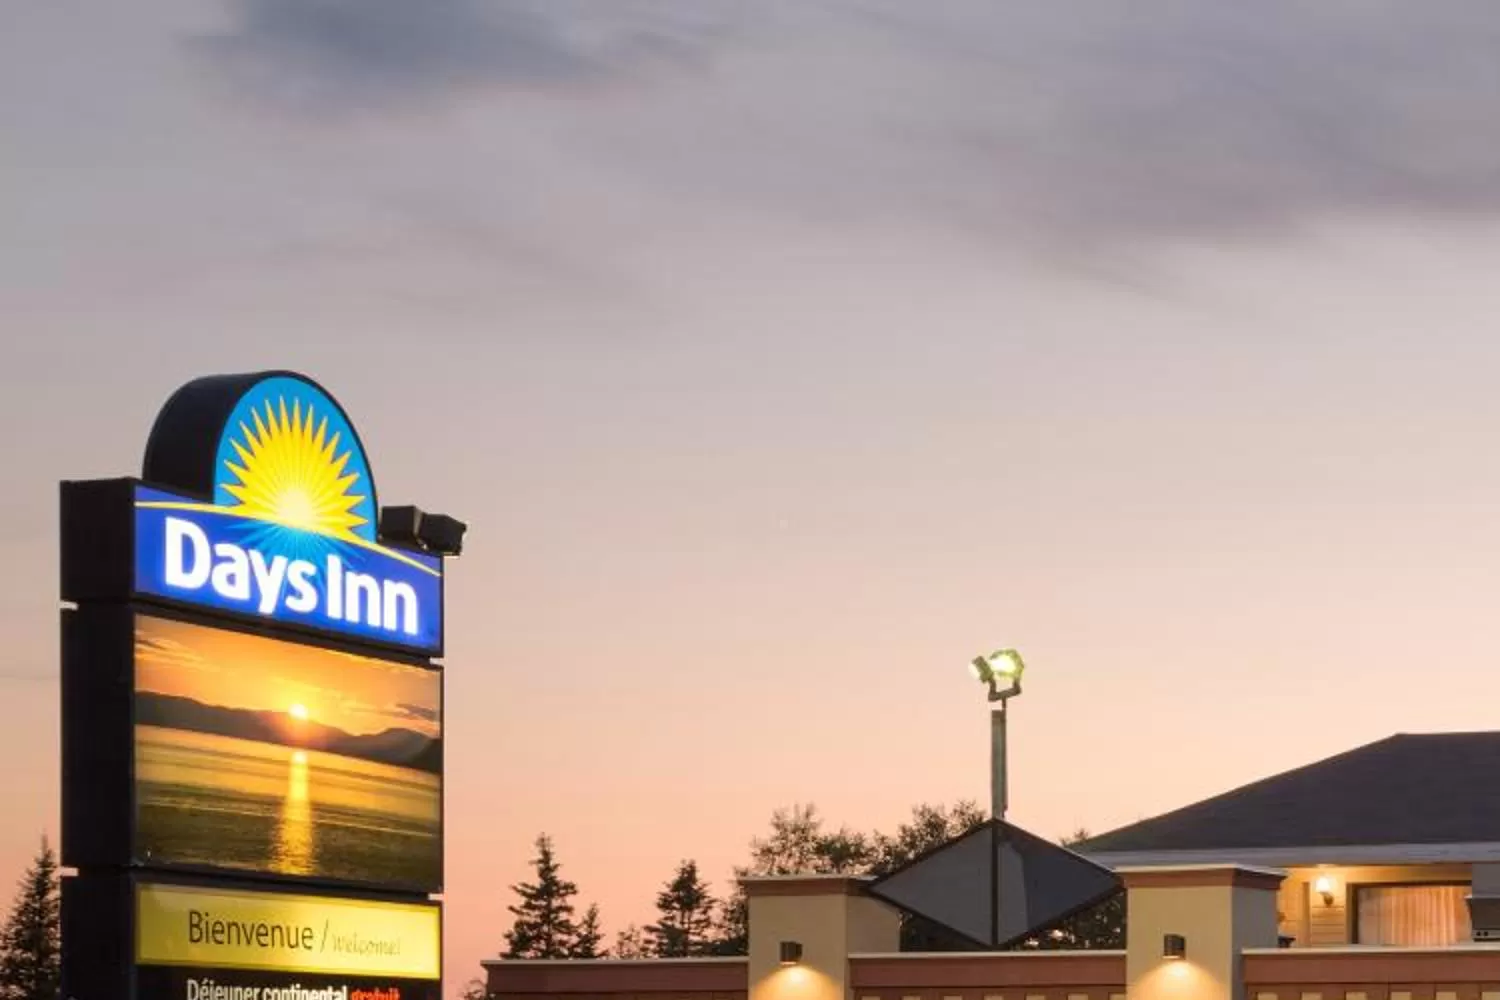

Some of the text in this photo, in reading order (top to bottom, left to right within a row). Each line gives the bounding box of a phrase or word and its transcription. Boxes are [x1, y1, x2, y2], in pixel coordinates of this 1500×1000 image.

[165, 516, 419, 636] Days Inn
[188, 909, 314, 951] Bienvenue
